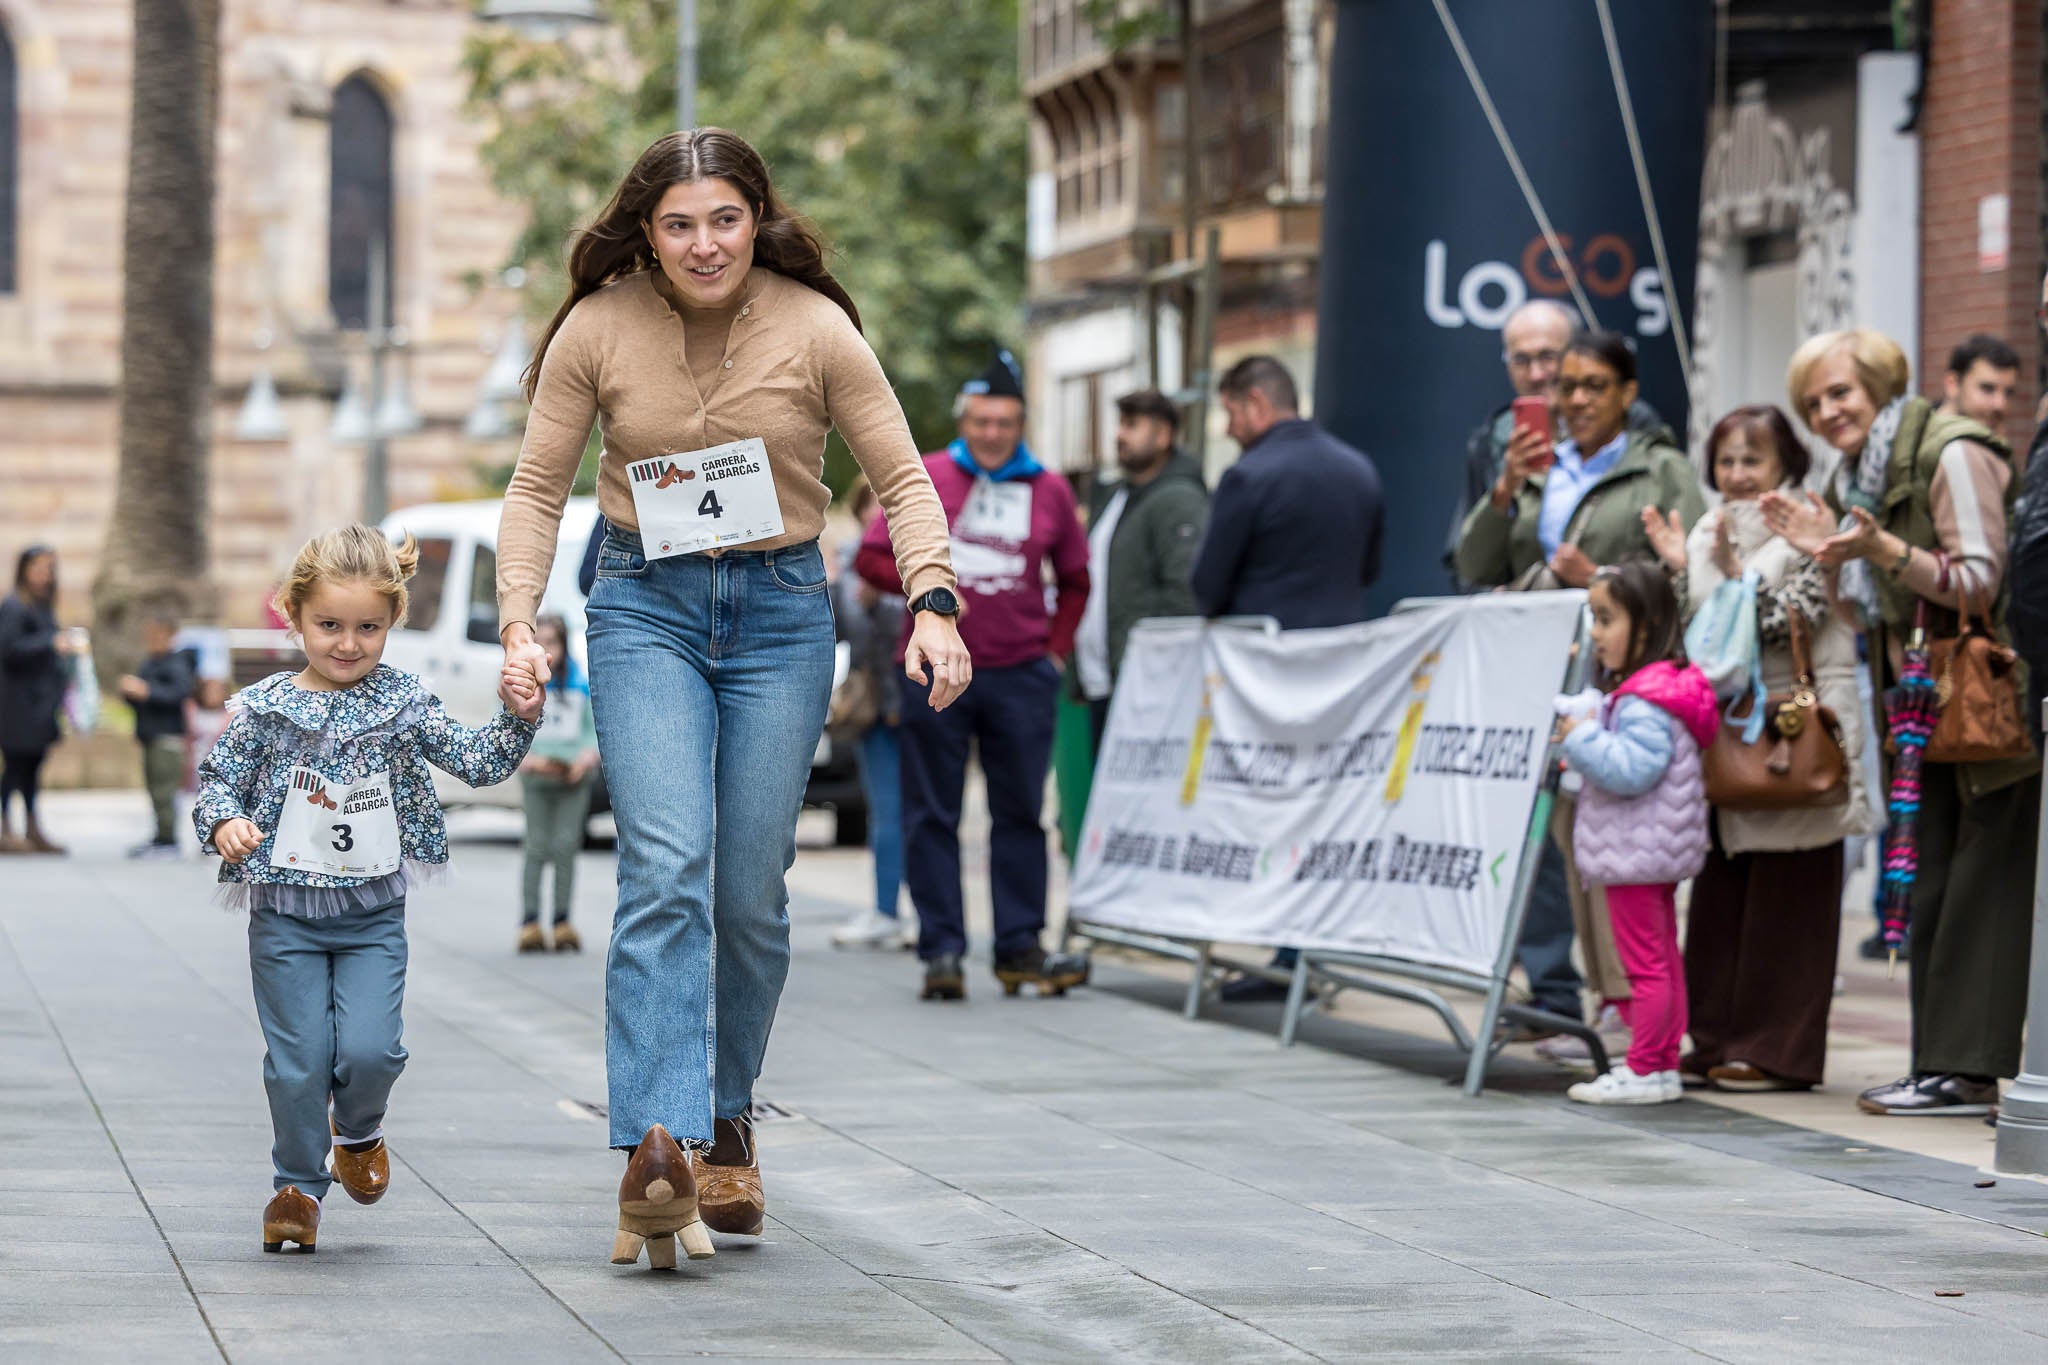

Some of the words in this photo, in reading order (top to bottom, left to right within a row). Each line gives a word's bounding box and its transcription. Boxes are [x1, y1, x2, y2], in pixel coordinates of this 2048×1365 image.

[702, 454, 748, 472] CARRERA
[705, 463, 761, 483] ALBARCAS
[698, 490, 723, 519] 4
[343, 796, 389, 816] ALBARCAS
[331, 824, 354, 853] 3
